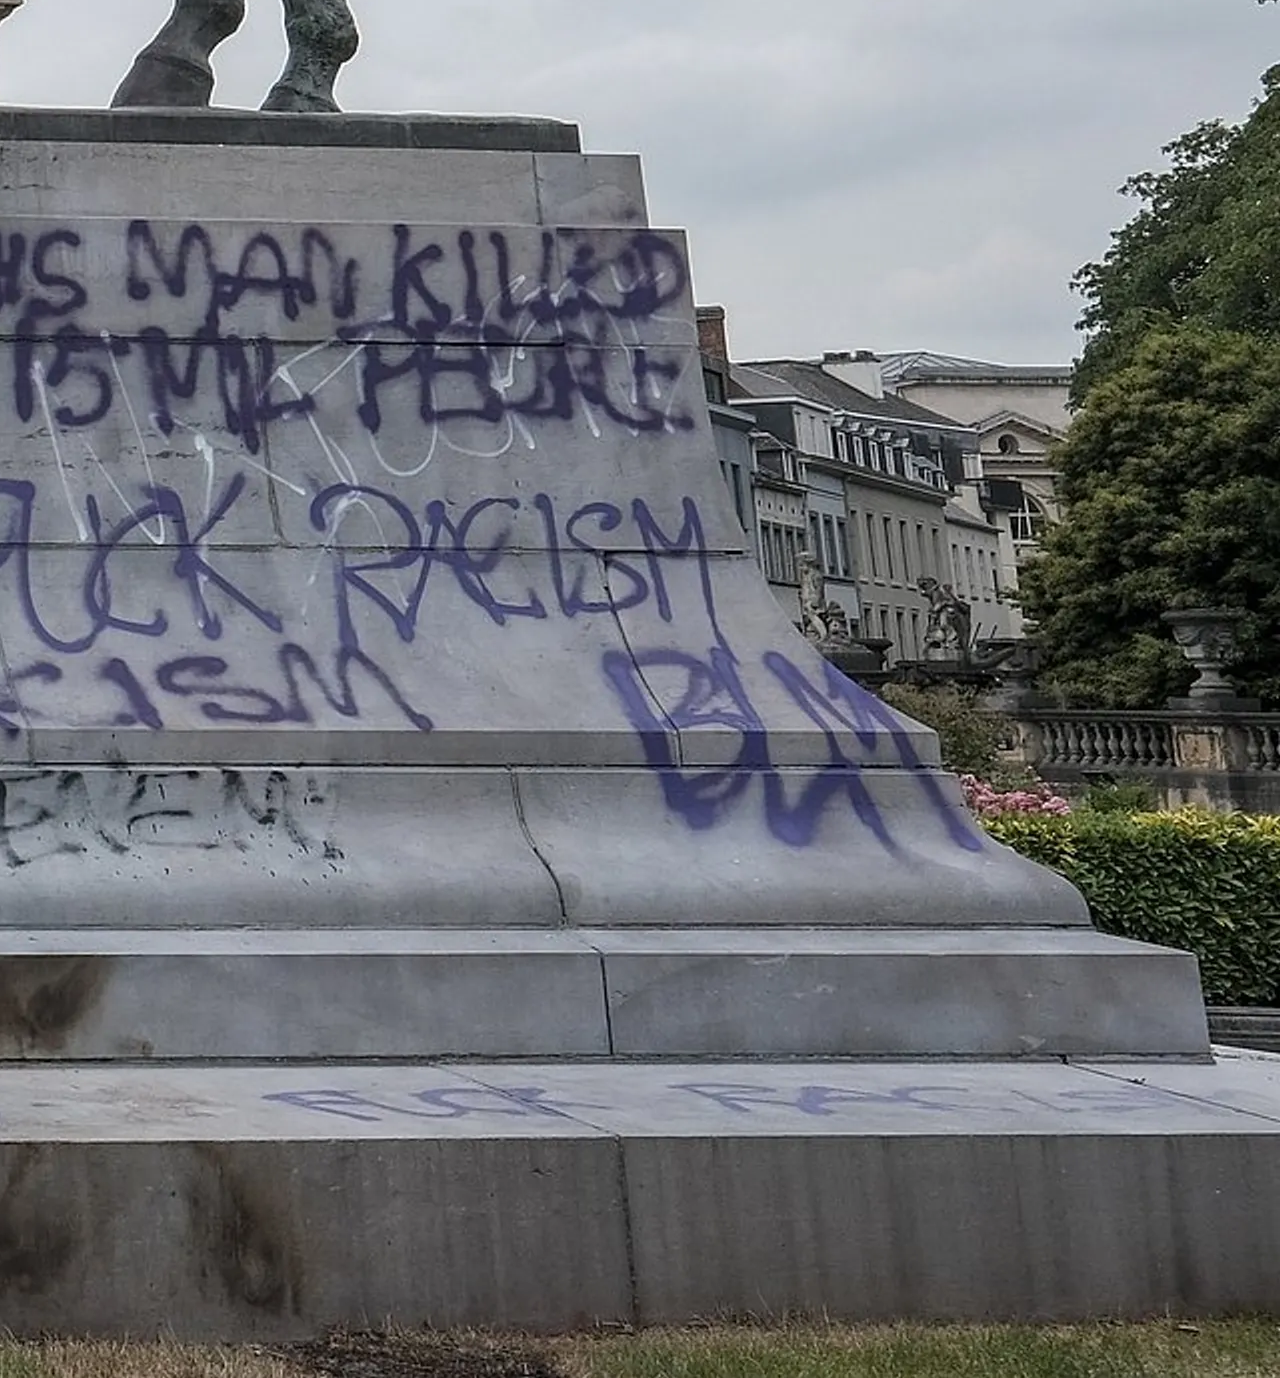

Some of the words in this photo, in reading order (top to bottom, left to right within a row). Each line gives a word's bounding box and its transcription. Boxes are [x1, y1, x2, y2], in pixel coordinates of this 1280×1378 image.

[126, 219, 359, 334] MAN
[308, 480, 740, 672] RACISM
[602, 644, 987, 872] BLM
